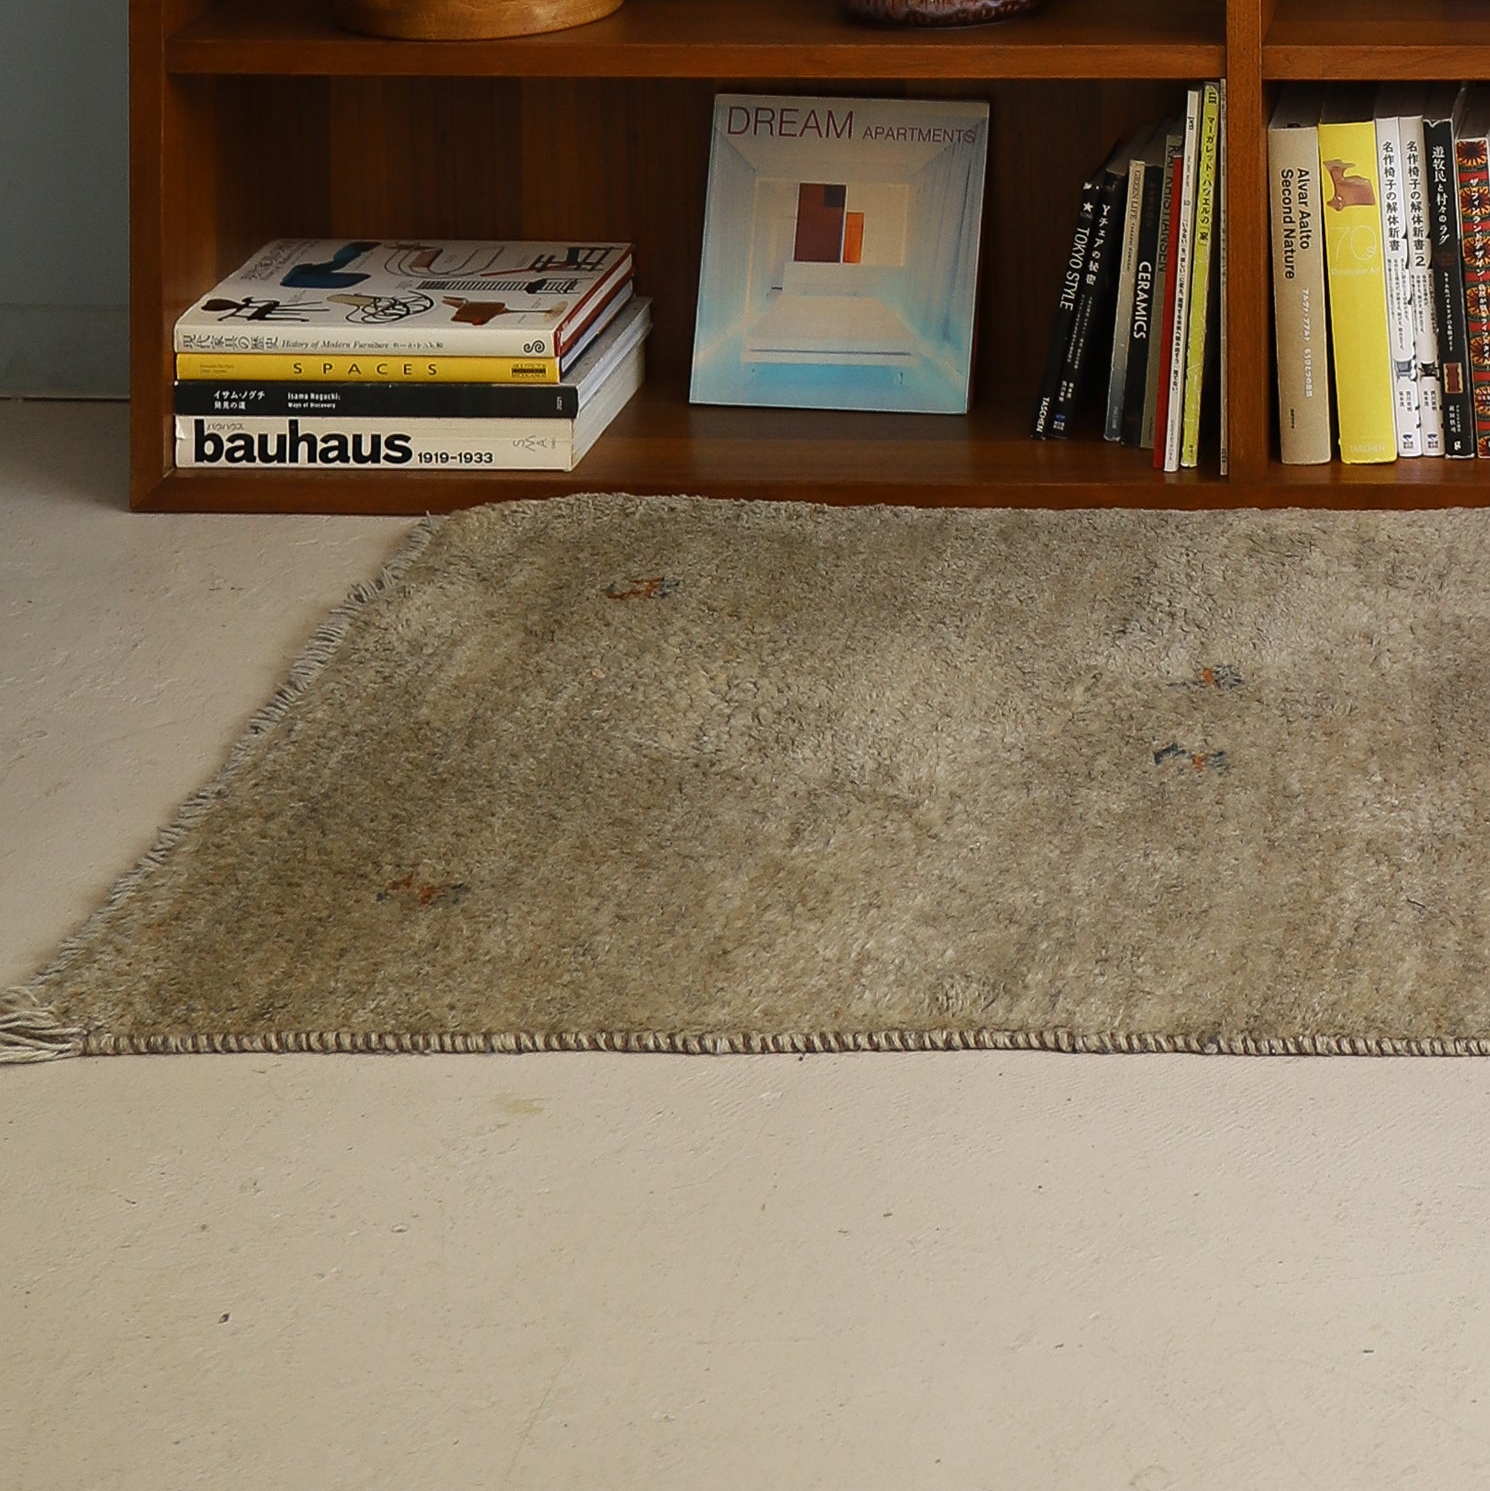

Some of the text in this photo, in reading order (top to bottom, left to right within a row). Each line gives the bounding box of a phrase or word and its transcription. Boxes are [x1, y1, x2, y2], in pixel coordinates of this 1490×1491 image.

[727, 106, 977, 144] DREAM APARTMENTS
[1131, 169, 1141, 202] GREEN
[1382, 140, 1400, 253] 名作椅子の解体新書
[1406, 140, 1425, 251] 名作椅子の解体新書
[1431, 145, 1450, 246] 遊牧民と村々のラグ
[1129, 202, 1139, 222] LIFE
[1280, 169, 1296, 279] Second Nature
[1296, 168, 1311, 250] Alvar Aalto
[1067, 226, 1091, 272] TOKYO
[1414, 255, 1426, 267] 2
[1059, 272, 1083, 311] STYLE
[1132, 260, 1152, 340] CERAMICS
[182, 334, 279, 351] 現代家具の歴史
[281, 339, 309, 350] History
[311, 339, 321, 349] of
[323, 339, 351, 349] Modern
[354, 340, 389, 350] Furniture
[293, 362, 439, 377] SPACES
[213, 390, 267, 401] イサム・ノグチ
[287, 392, 308, 401] Isamu
[1036, 396, 1051, 433] TASCHEN
[194, 419, 494, 465] bauhaus 1919-1933
